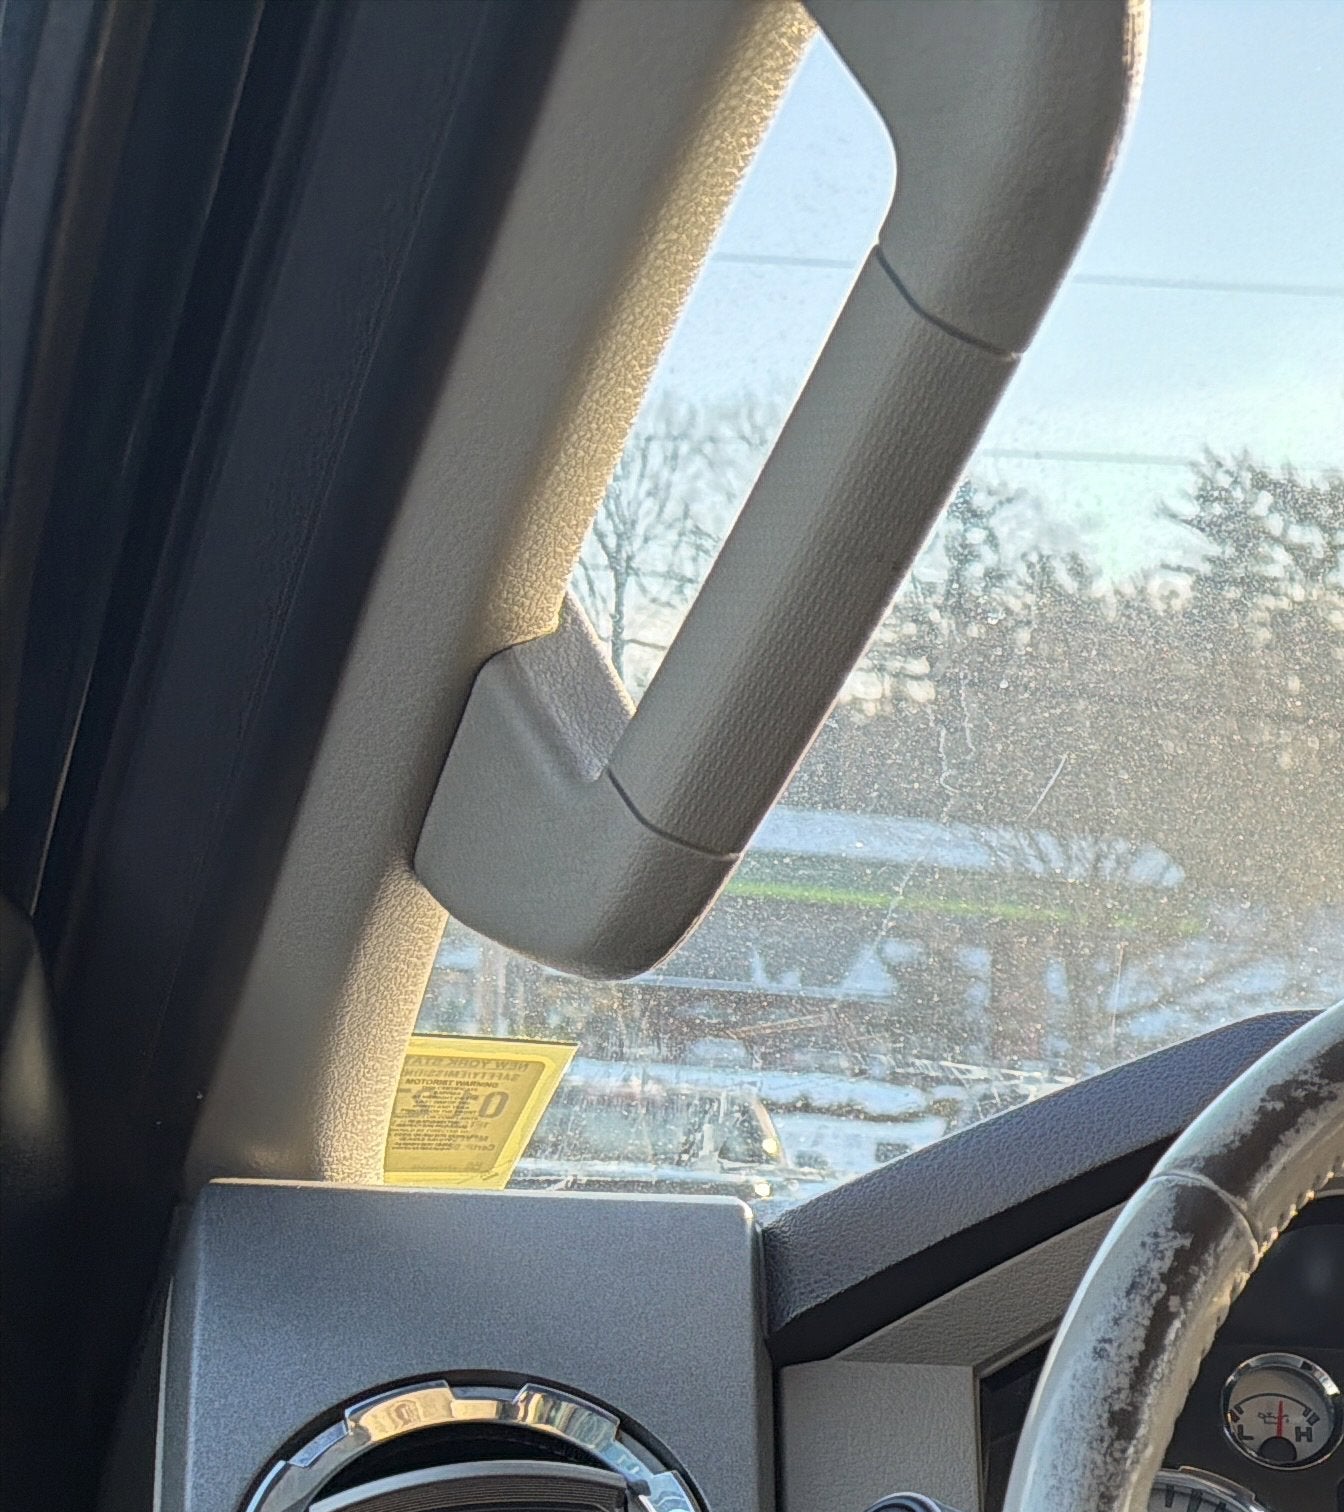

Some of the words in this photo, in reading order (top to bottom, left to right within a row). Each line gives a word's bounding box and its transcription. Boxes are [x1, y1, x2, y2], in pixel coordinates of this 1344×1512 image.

[456, 1079, 499, 1088] WARNING
[1237, 1424, 1254, 1441] L
[1295, 1425, 1313, 1442] H
